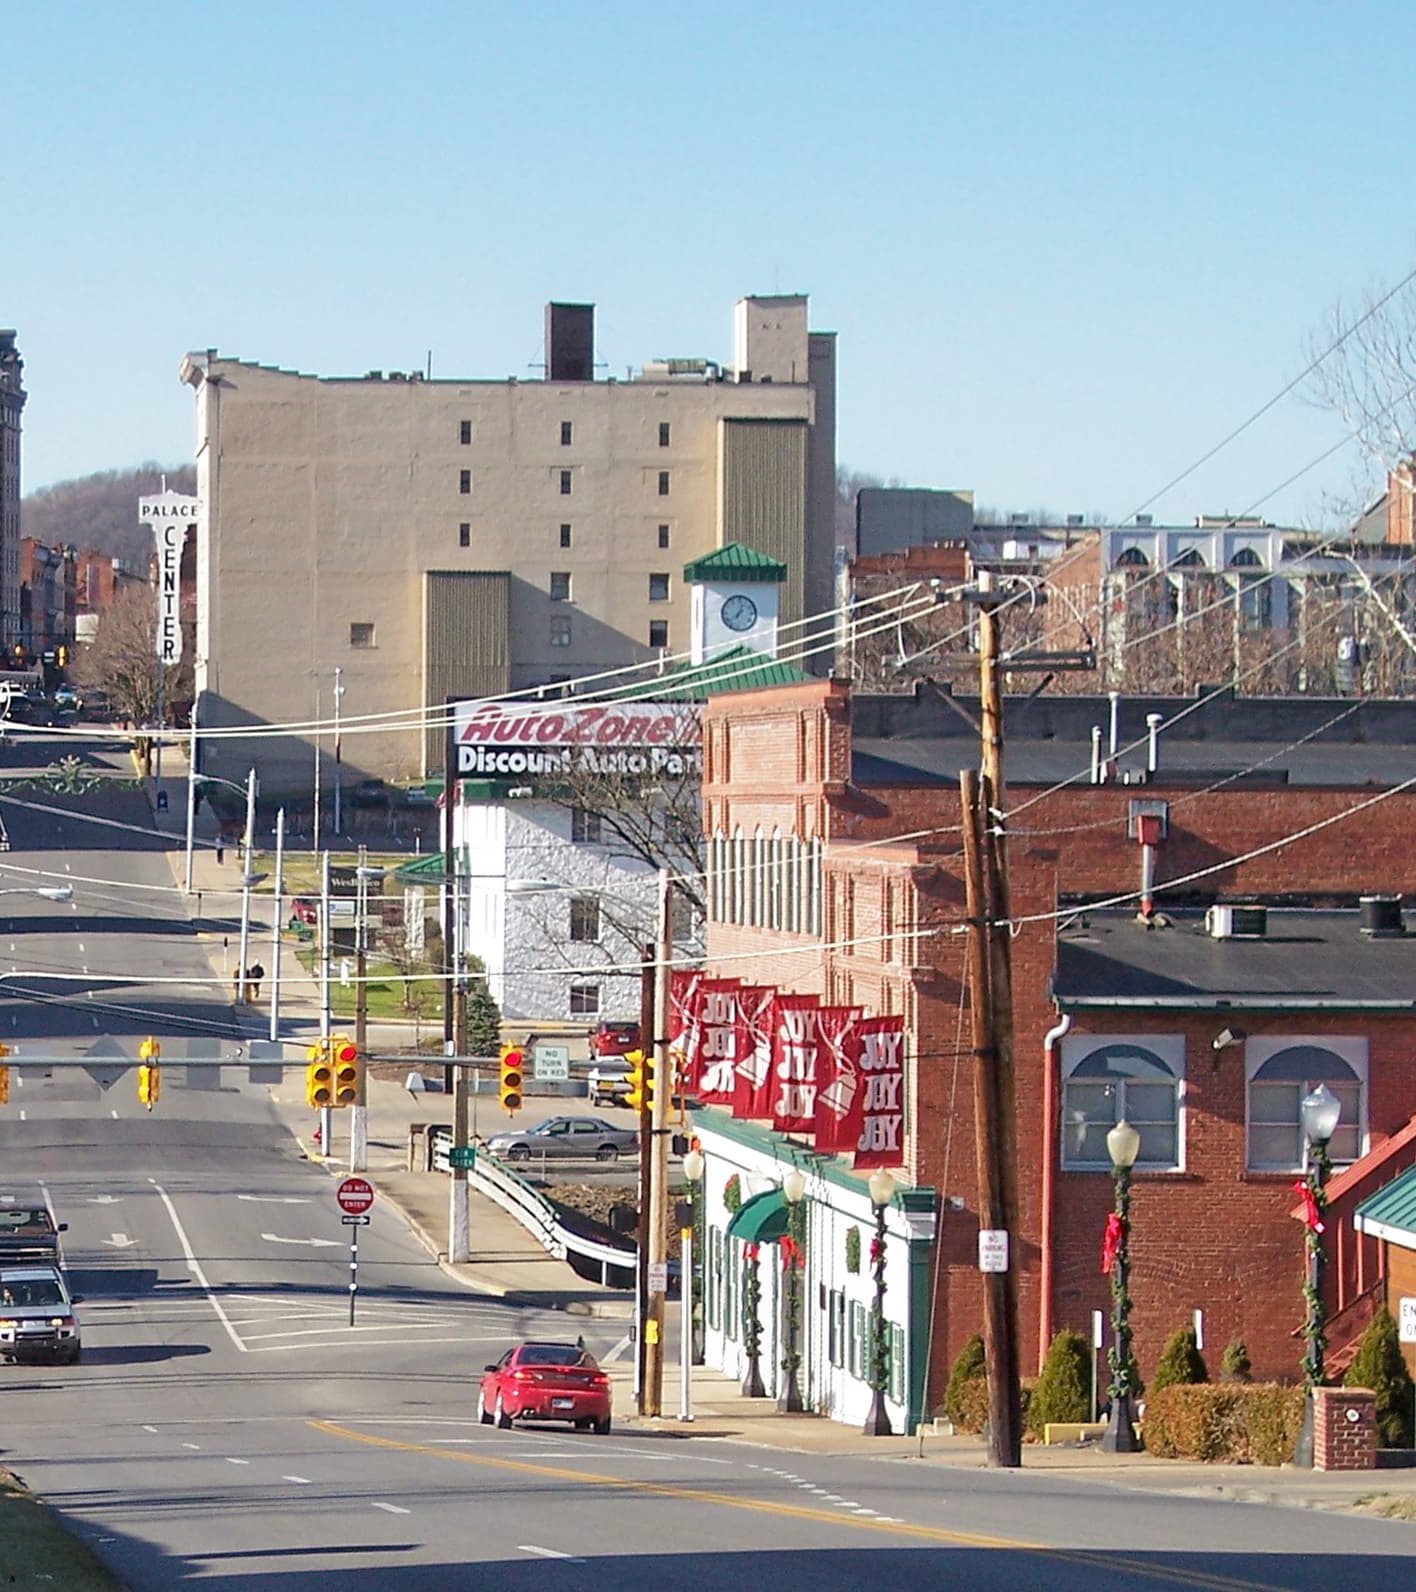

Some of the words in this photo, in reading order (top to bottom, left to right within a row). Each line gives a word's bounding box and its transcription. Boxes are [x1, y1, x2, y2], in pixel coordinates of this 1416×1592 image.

[142, 504, 198, 517] PALACE
[162, 526, 176, 661] CENTER
[458, 747, 571, 772] Discount
[776, 1010, 817, 1042] JOY
[860, 1031, 902, 1070] JOY
[775, 1084, 818, 1118] JOY
[863, 1073, 903, 1111] JOY
[857, 1115, 902, 1151] JOY
[342, 1184, 353, 1192] DO
[354, 1184, 369, 1192] NOT
[344, 1200, 366, 1208] ENTER
